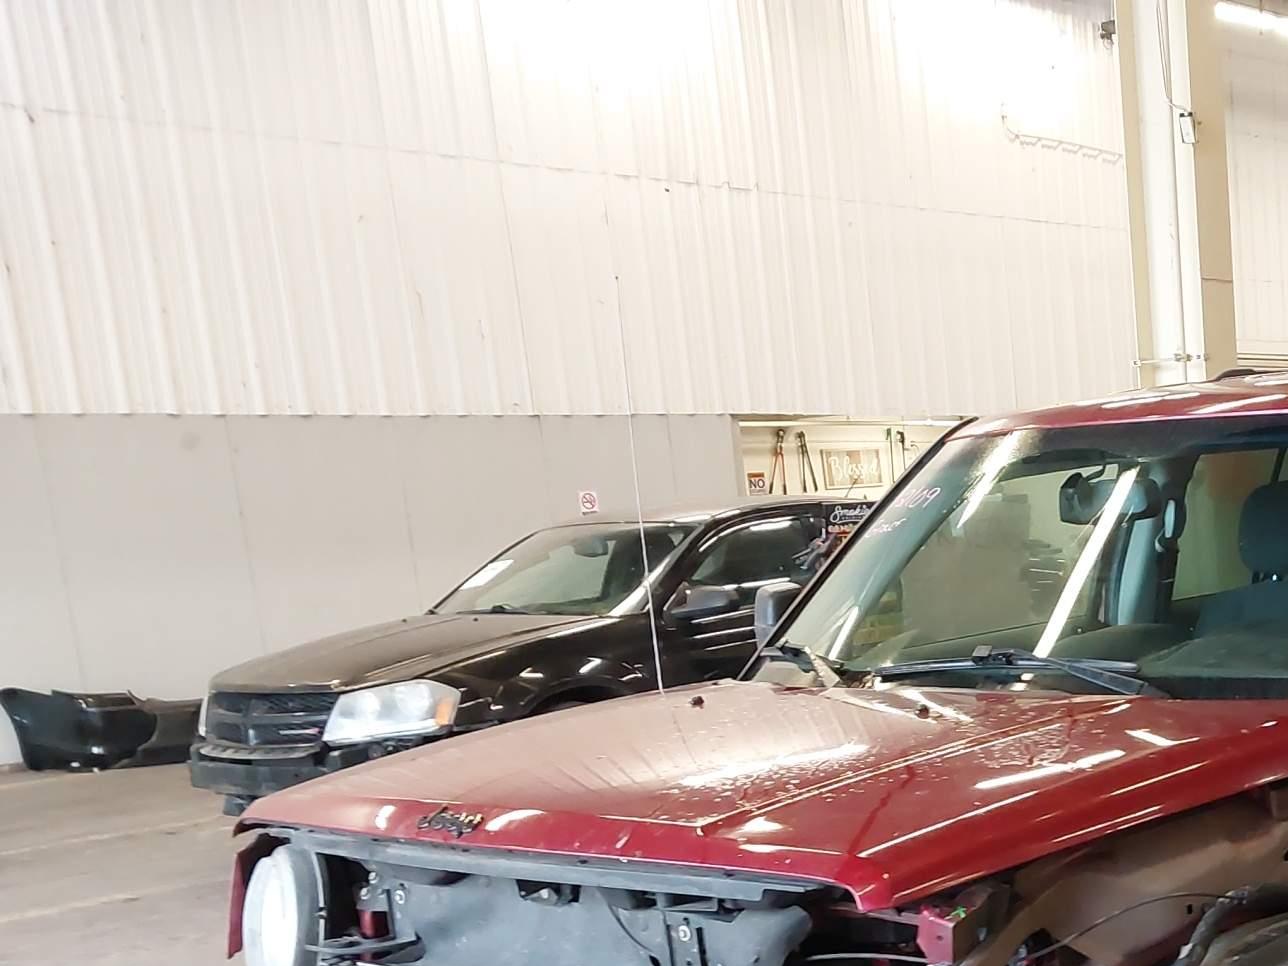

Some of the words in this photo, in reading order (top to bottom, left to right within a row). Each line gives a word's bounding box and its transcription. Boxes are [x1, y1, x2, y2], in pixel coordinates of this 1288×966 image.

[828, 456, 879, 480] Blessed
[749, 478, 765, 489] NO
[417, 804, 484, 839] Jeep
